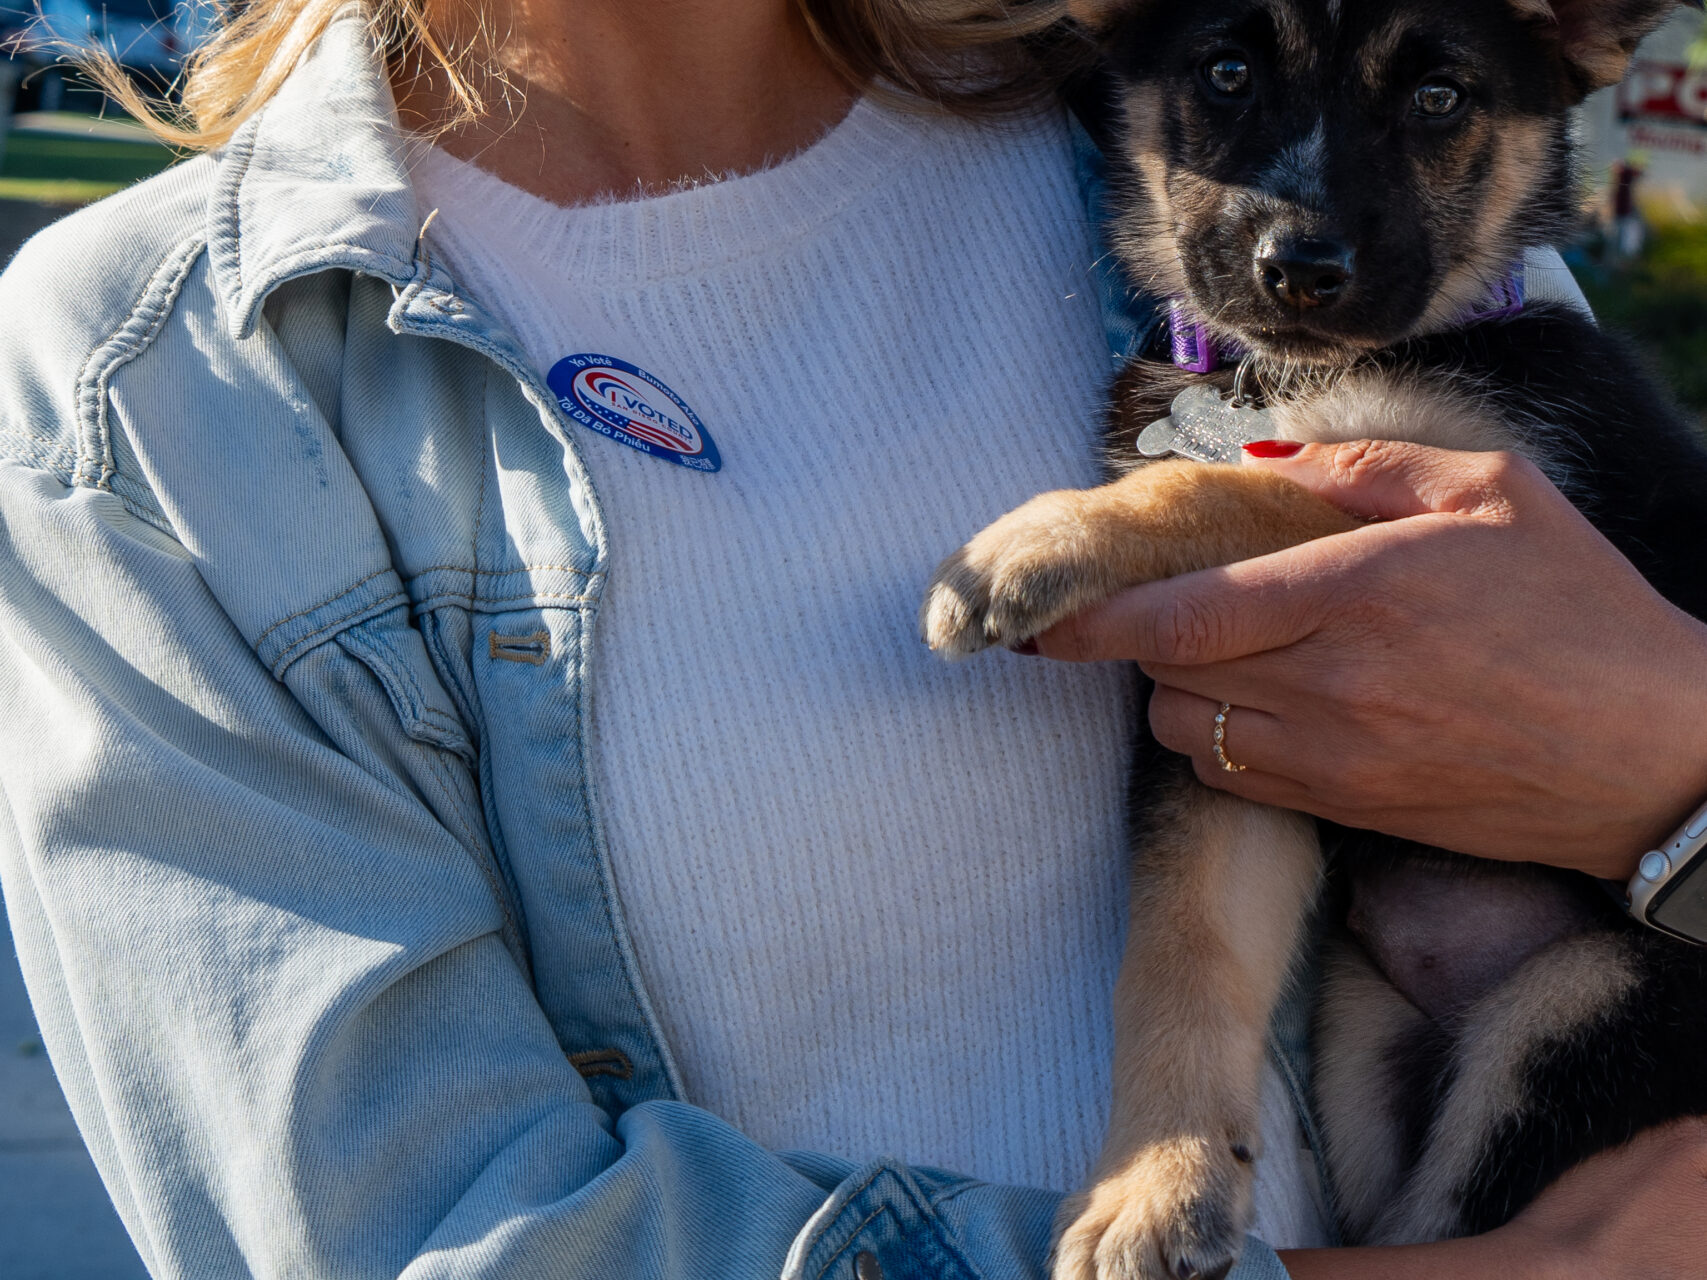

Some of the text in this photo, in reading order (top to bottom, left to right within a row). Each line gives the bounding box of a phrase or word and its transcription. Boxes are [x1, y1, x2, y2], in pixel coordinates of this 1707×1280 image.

[568, 356, 613, 368] Yo Voté
[557, 396, 577, 412] Tôi
[573, 410, 592, 424] Đã
[611, 391, 693, 440] I VOTED
[638, 369, 699, 426] Bumoto Ako
